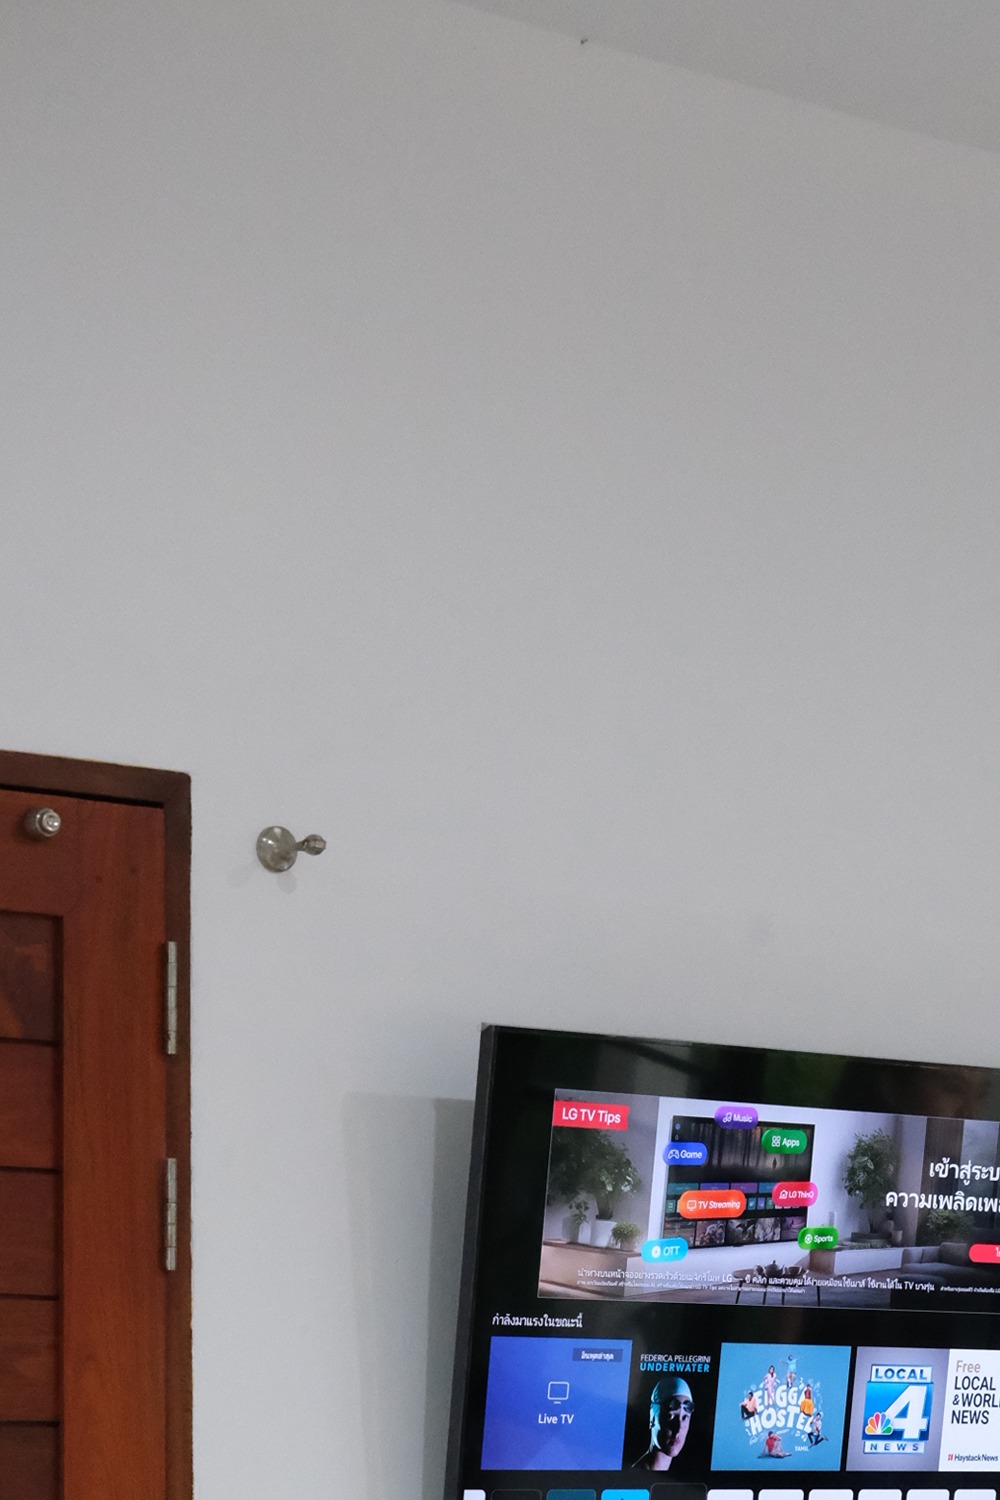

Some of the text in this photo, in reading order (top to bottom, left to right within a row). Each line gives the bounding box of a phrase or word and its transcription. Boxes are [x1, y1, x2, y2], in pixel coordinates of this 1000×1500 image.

[562, 1107, 621, 1126] LG TV Tips
[733, 1113, 753, 1123] Music
[782, 1137, 800, 1148] Apps
[680, 1149, 703, 1159] Game
[788, 1189, 815, 1199] LG ThinQ
[698, 1200, 741, 1212] TV Streaming
[814, 1234, 834, 1244] Sports
[663, 1245, 680, 1256] OTT
[722, 1274, 733, 1283] LG
[904, 1281, 914, 1290] TV
[492, 1313, 583, 1328] กำลังมาแรงในขณะนี้
[640, 1354, 711, 1363] FEDERICA PELLEGRINI
[640, 1362, 710, 1372] UNDERWATER
[956, 1360, 981, 1373] Free
[875, 1368, 927, 1379] LOCAL
[954, 1376, 996, 1390] LOCAL
[884, 1384, 929, 1440] 4
[951, 1410, 989, 1424] NEWS
[538, 1414, 574, 1424] Live TV
[749, 1405, 815, 1436] HOSTEL
[870, 1443, 919, 1451] NEWS
